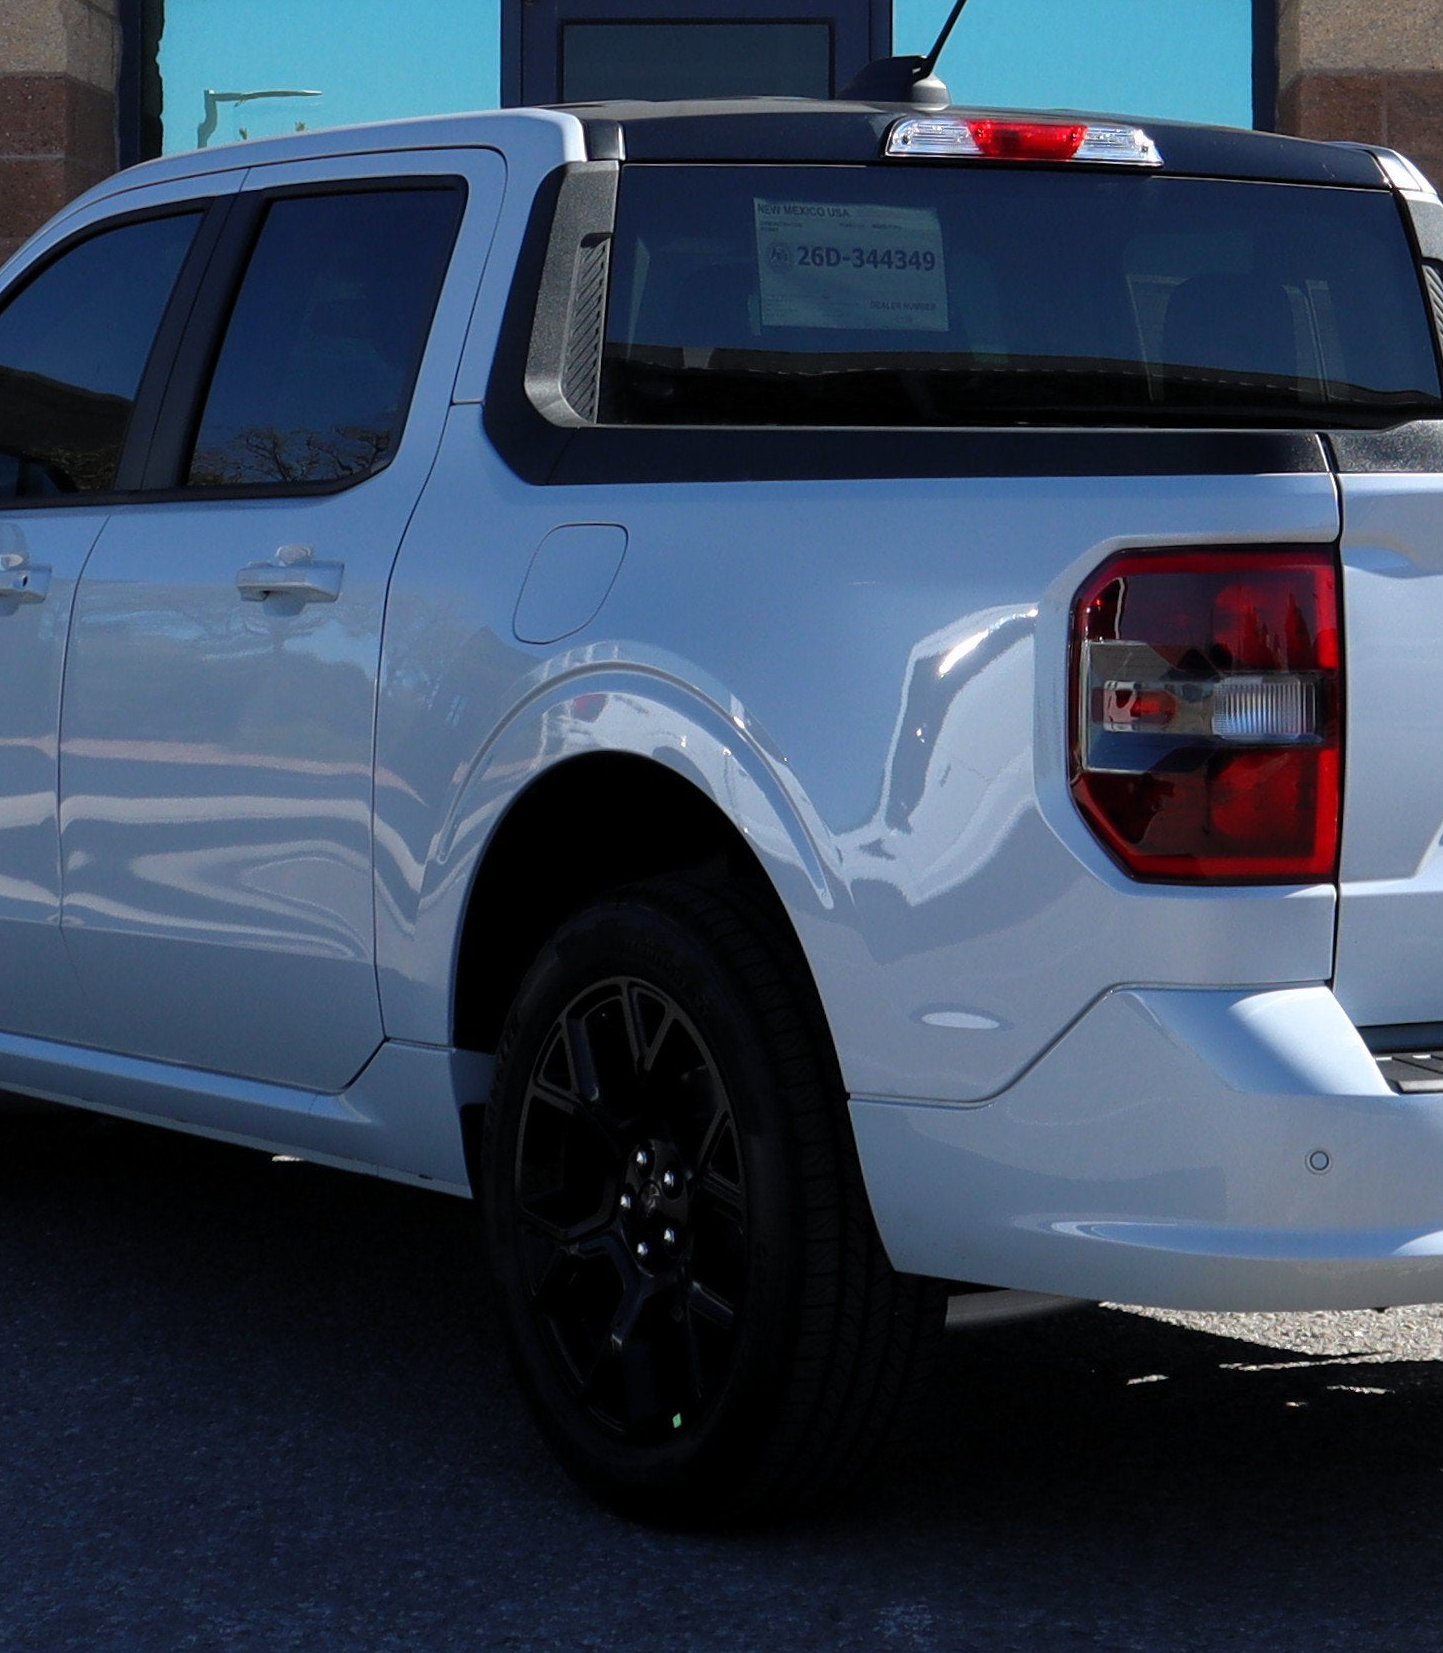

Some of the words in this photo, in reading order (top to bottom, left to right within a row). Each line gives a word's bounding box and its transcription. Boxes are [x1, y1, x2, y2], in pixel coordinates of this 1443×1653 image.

[757, 203, 781, 215] NEW
[783, 205, 826, 217] MEXICO
[827, 208, 850, 218] USA
[797, 246, 936, 271] 26D-344349
[870, 300, 902, 311] DEALER
